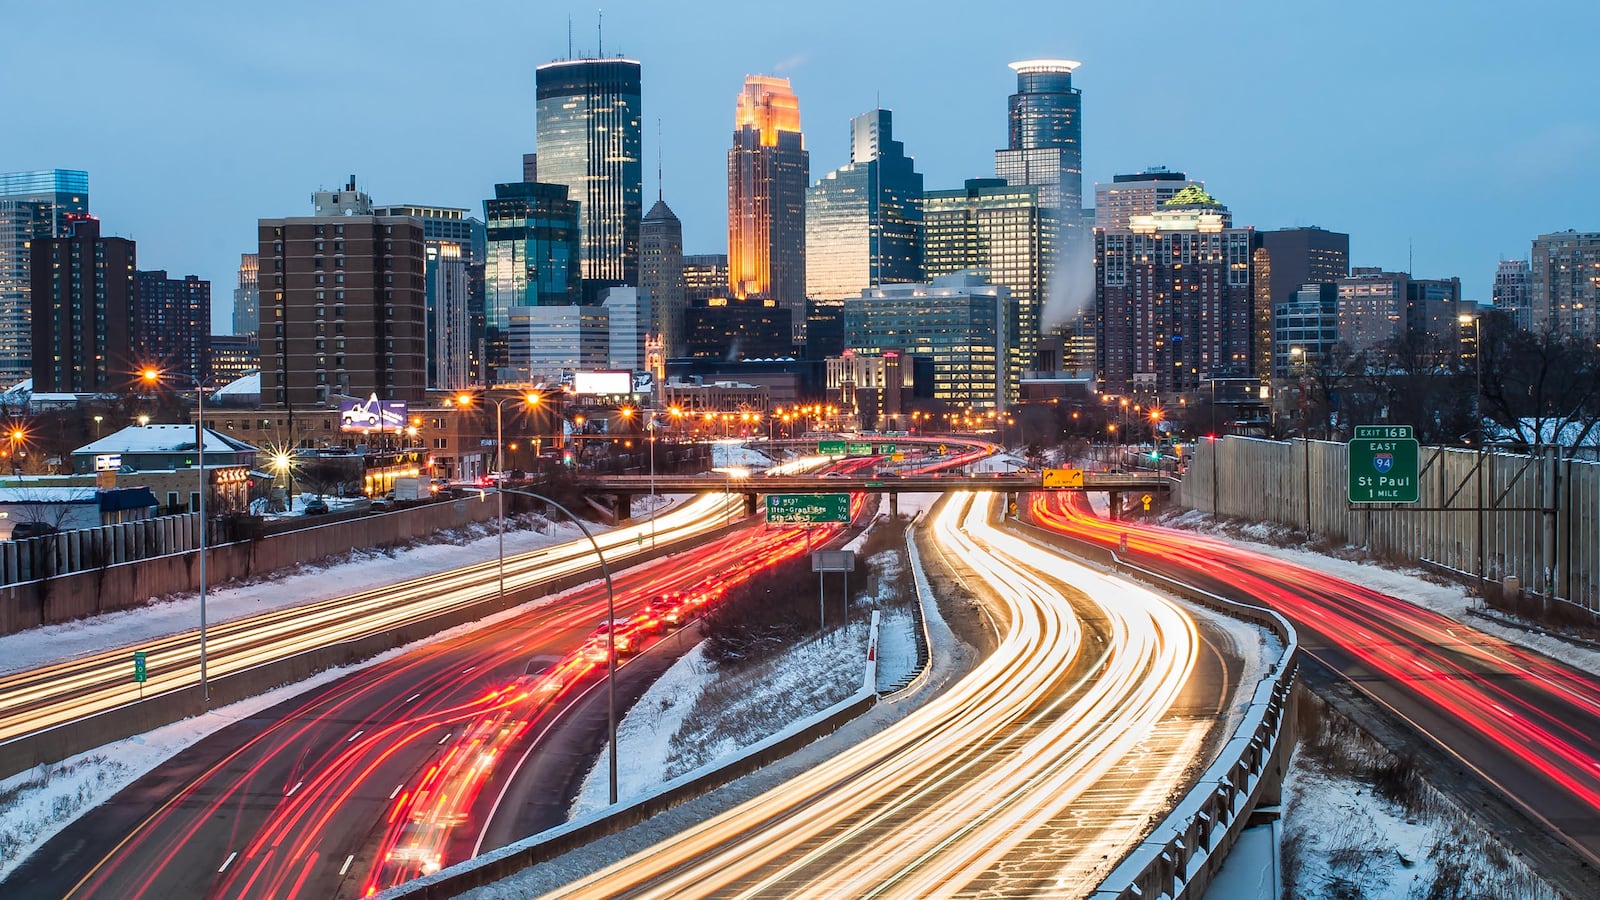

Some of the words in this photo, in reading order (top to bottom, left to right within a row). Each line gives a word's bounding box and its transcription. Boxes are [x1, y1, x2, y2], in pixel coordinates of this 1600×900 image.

[1385, 428, 1407, 437] 16B
[1370, 442, 1397, 451] EAST
[1376, 458, 1390, 468] 94
[1358, 476, 1373, 486] St
[1379, 476, 1410, 486] Paul
[1369, 489, 1373, 498] 1
[771, 506, 810, 514] 11th-Grant
